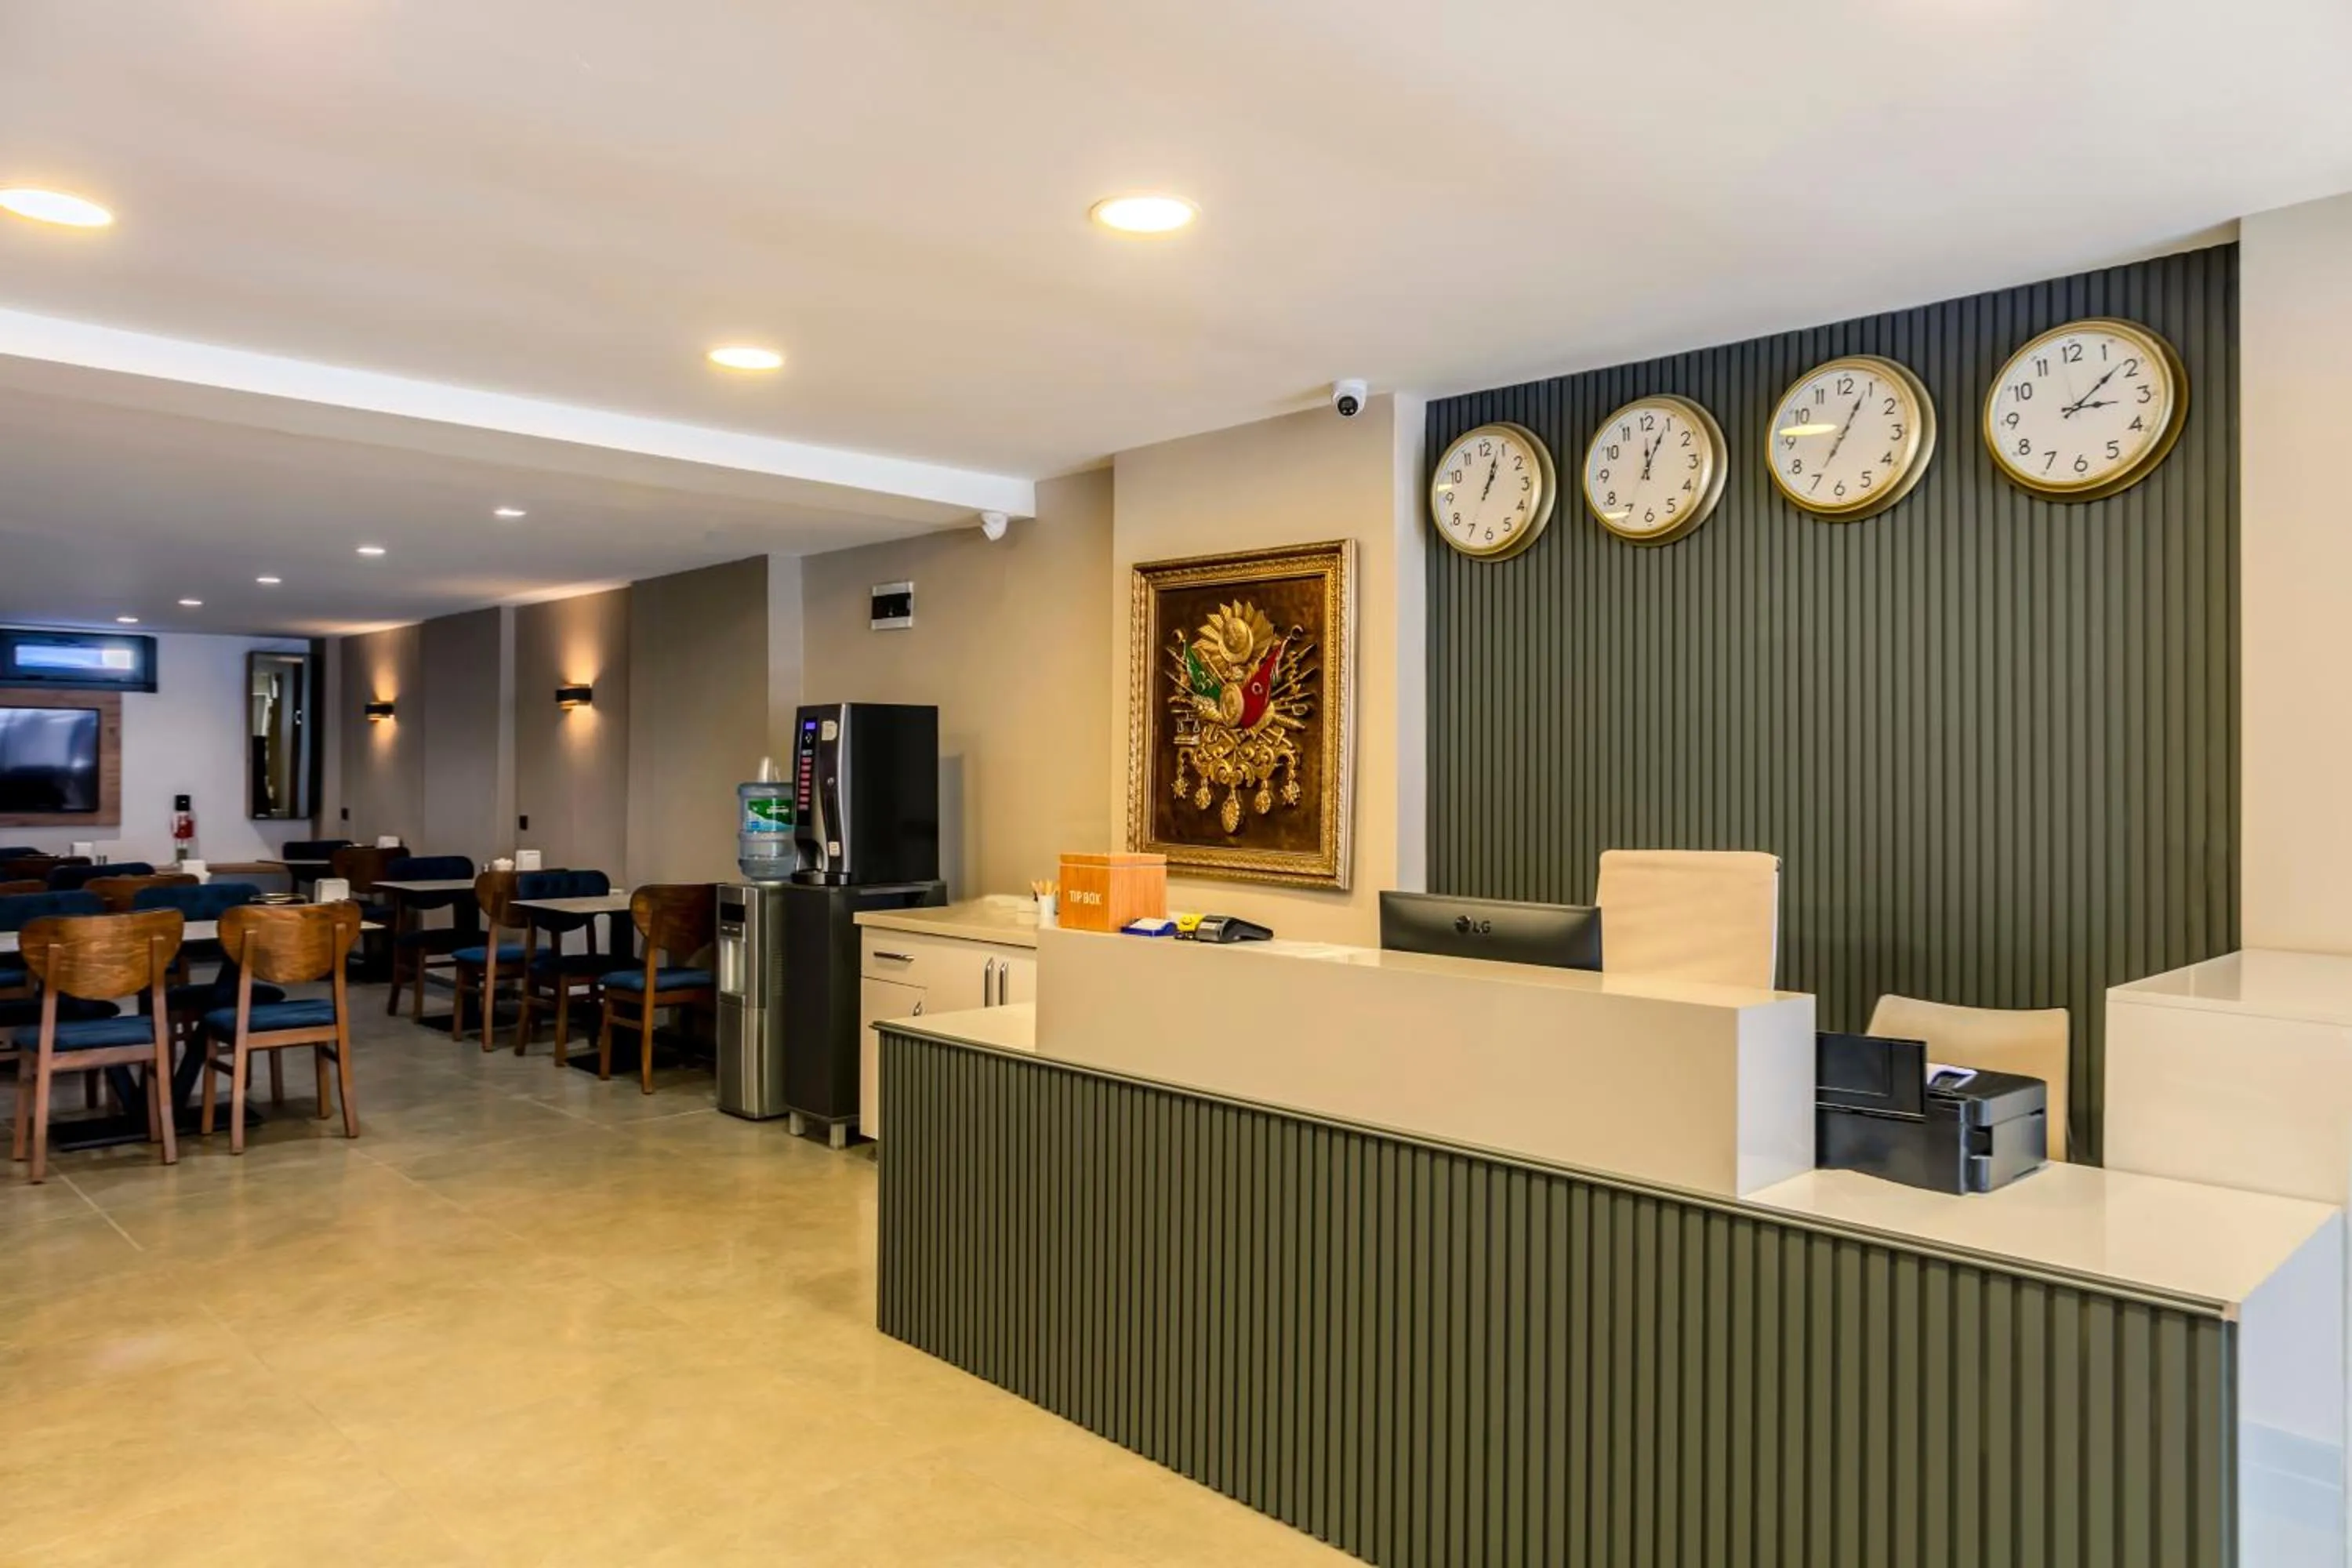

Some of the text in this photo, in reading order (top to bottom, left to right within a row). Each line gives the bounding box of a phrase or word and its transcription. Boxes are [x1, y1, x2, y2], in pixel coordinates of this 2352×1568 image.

[2062, 344, 2082, 364] 12
[2102, 343, 2107, 361] 1
[2036, 359, 2048, 377] 11
[2124, 358, 2138, 378] 2
[1837, 378, 1854, 396] 12
[1869, 382, 1873, 397] 1
[2013, 382, 2033, 401] 10
[2136, 385, 2151, 403] 3
[1815, 389, 1824, 405] 11
[1884, 397, 1895, 415] 2
[1640, 415, 1654, 431] 12
[1795, 408, 1809, 424] 10
[2006, 412, 2020, 430] 9
[2129, 416, 2143, 431] 4
[1622, 426, 1630, 441] 11
[1681, 430, 1690, 447] 2
[1890, 424, 1902, 441] 3
[1479, 441, 1491, 457] 12
[1785, 435, 1796, 450] 9
[2019, 439, 2031, 456] 8
[2106, 441, 2119, 459] 5
[1464, 453, 1472, 465] 11
[1606, 445, 1618, 460] 10
[1881, 451, 1892, 466] 4
[1514, 456, 1523, 470] 2
[1688, 454, 1698, 470] 3
[1792, 459, 1802, 474] 8
[2044, 451, 2057, 470] 7
[2074, 454, 2088, 472] 6
[1451, 470, 1461, 483] 10
[1599, 468, 1610, 483] 9
[1811, 474, 1823, 491] 7
[1860, 471, 1871, 488] 5
[1521, 477, 1529, 491] 3
[1682, 479, 1692, 492] 4
[1834, 481, 1845, 496] 6
[1446, 492, 1454, 504] 9
[1516, 499, 1525, 511] 4
[1607, 492, 1616, 506] 8
[1667, 498, 1675, 513] 5
[1453, 512, 1461, 525] 8
[1645, 508, 1654, 522] 6
[1468, 523, 1475, 538] 7
[1503, 517, 1512, 532] 5
[1485, 528, 1494, 540] 6
[1069, 891, 1102, 905] TIP BOX
[1472, 920, 1491, 933] LG
